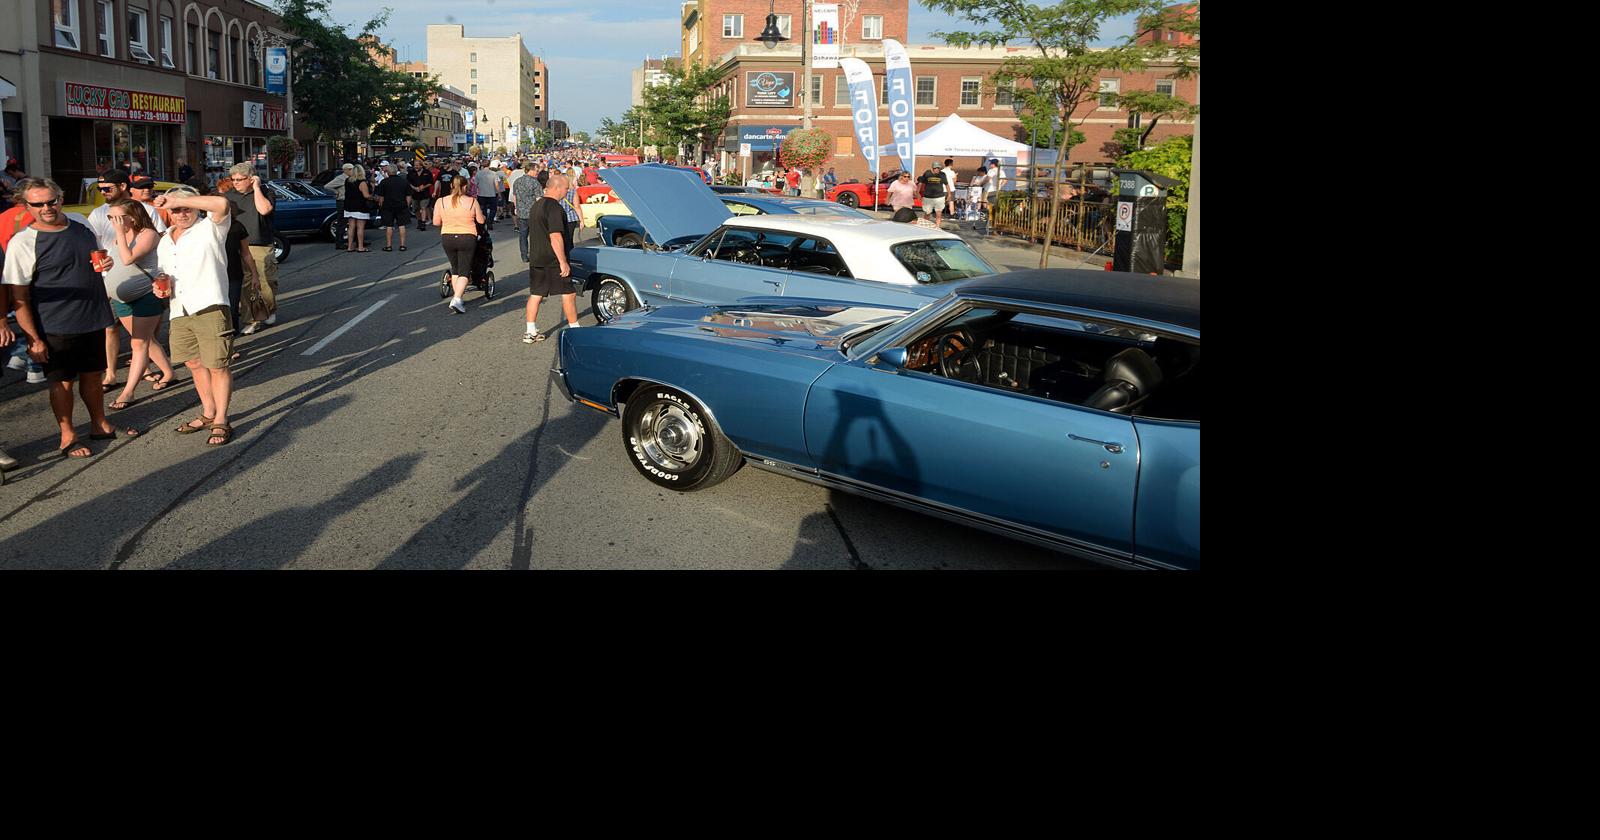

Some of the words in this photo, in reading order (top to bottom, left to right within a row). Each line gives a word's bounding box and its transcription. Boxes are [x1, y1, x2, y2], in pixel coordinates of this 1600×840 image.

[67, 84, 107, 107] LUCKY
[108, 89, 131, 110] CHO
[131, 93, 185, 114] RESTAURANT
[1120, 180, 1136, 189] 7388
[656, 392, 691, 410] EAGLE
[630, 436, 679, 481] GOODYEAR
